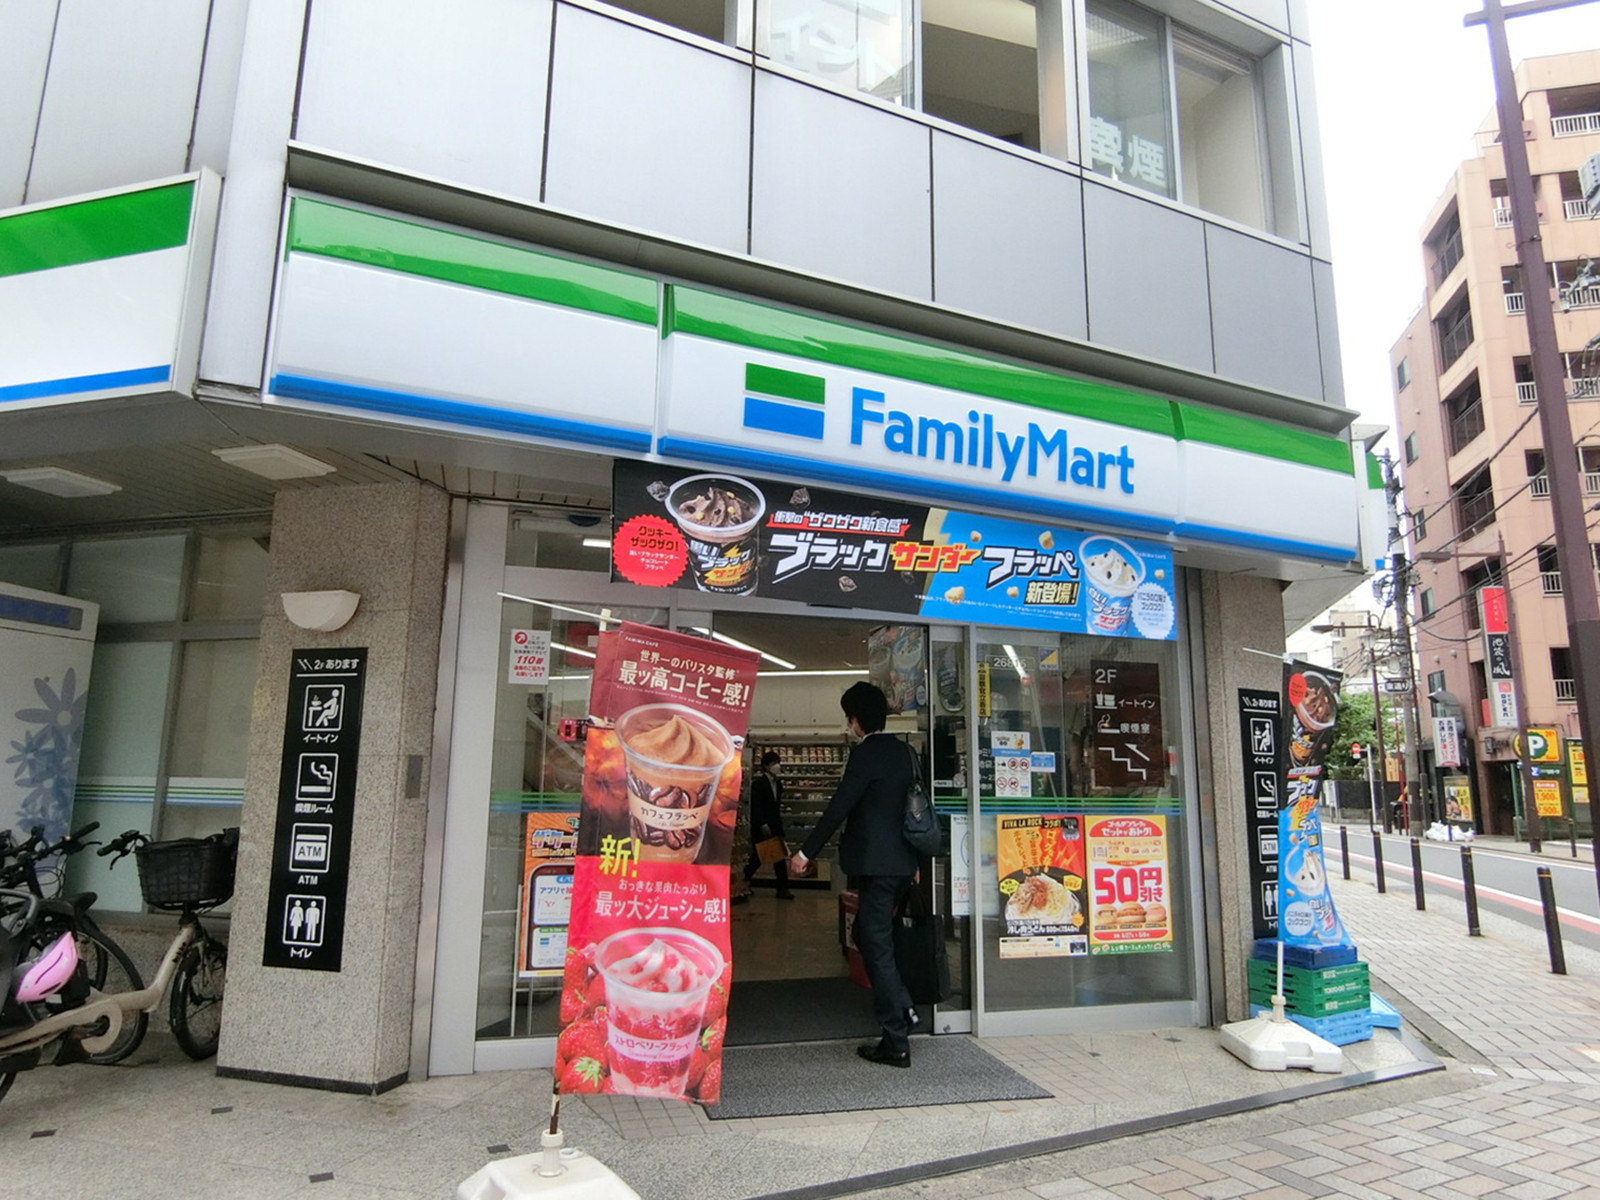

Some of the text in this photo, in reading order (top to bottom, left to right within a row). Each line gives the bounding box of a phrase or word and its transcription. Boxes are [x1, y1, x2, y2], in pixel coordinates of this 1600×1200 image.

[850, 386, 1135, 494] FamilyMart
[638, 525, 673, 538] クッキー
[1025, 581, 1080, 606] 新登場!
[1095, 668, 1117, 684] 2F
[1118, 699, 1155, 709] イートイン
[303, 734, 339, 743] イートイン
[1527, 735, 1545, 756] P
[298, 845, 322, 857] ATM
[1263, 842, 1276, 851] ATM
[598, 834, 642, 878] 新!
[297, 875, 319, 885] ATM
[290, 947, 313, 958] トイレ
